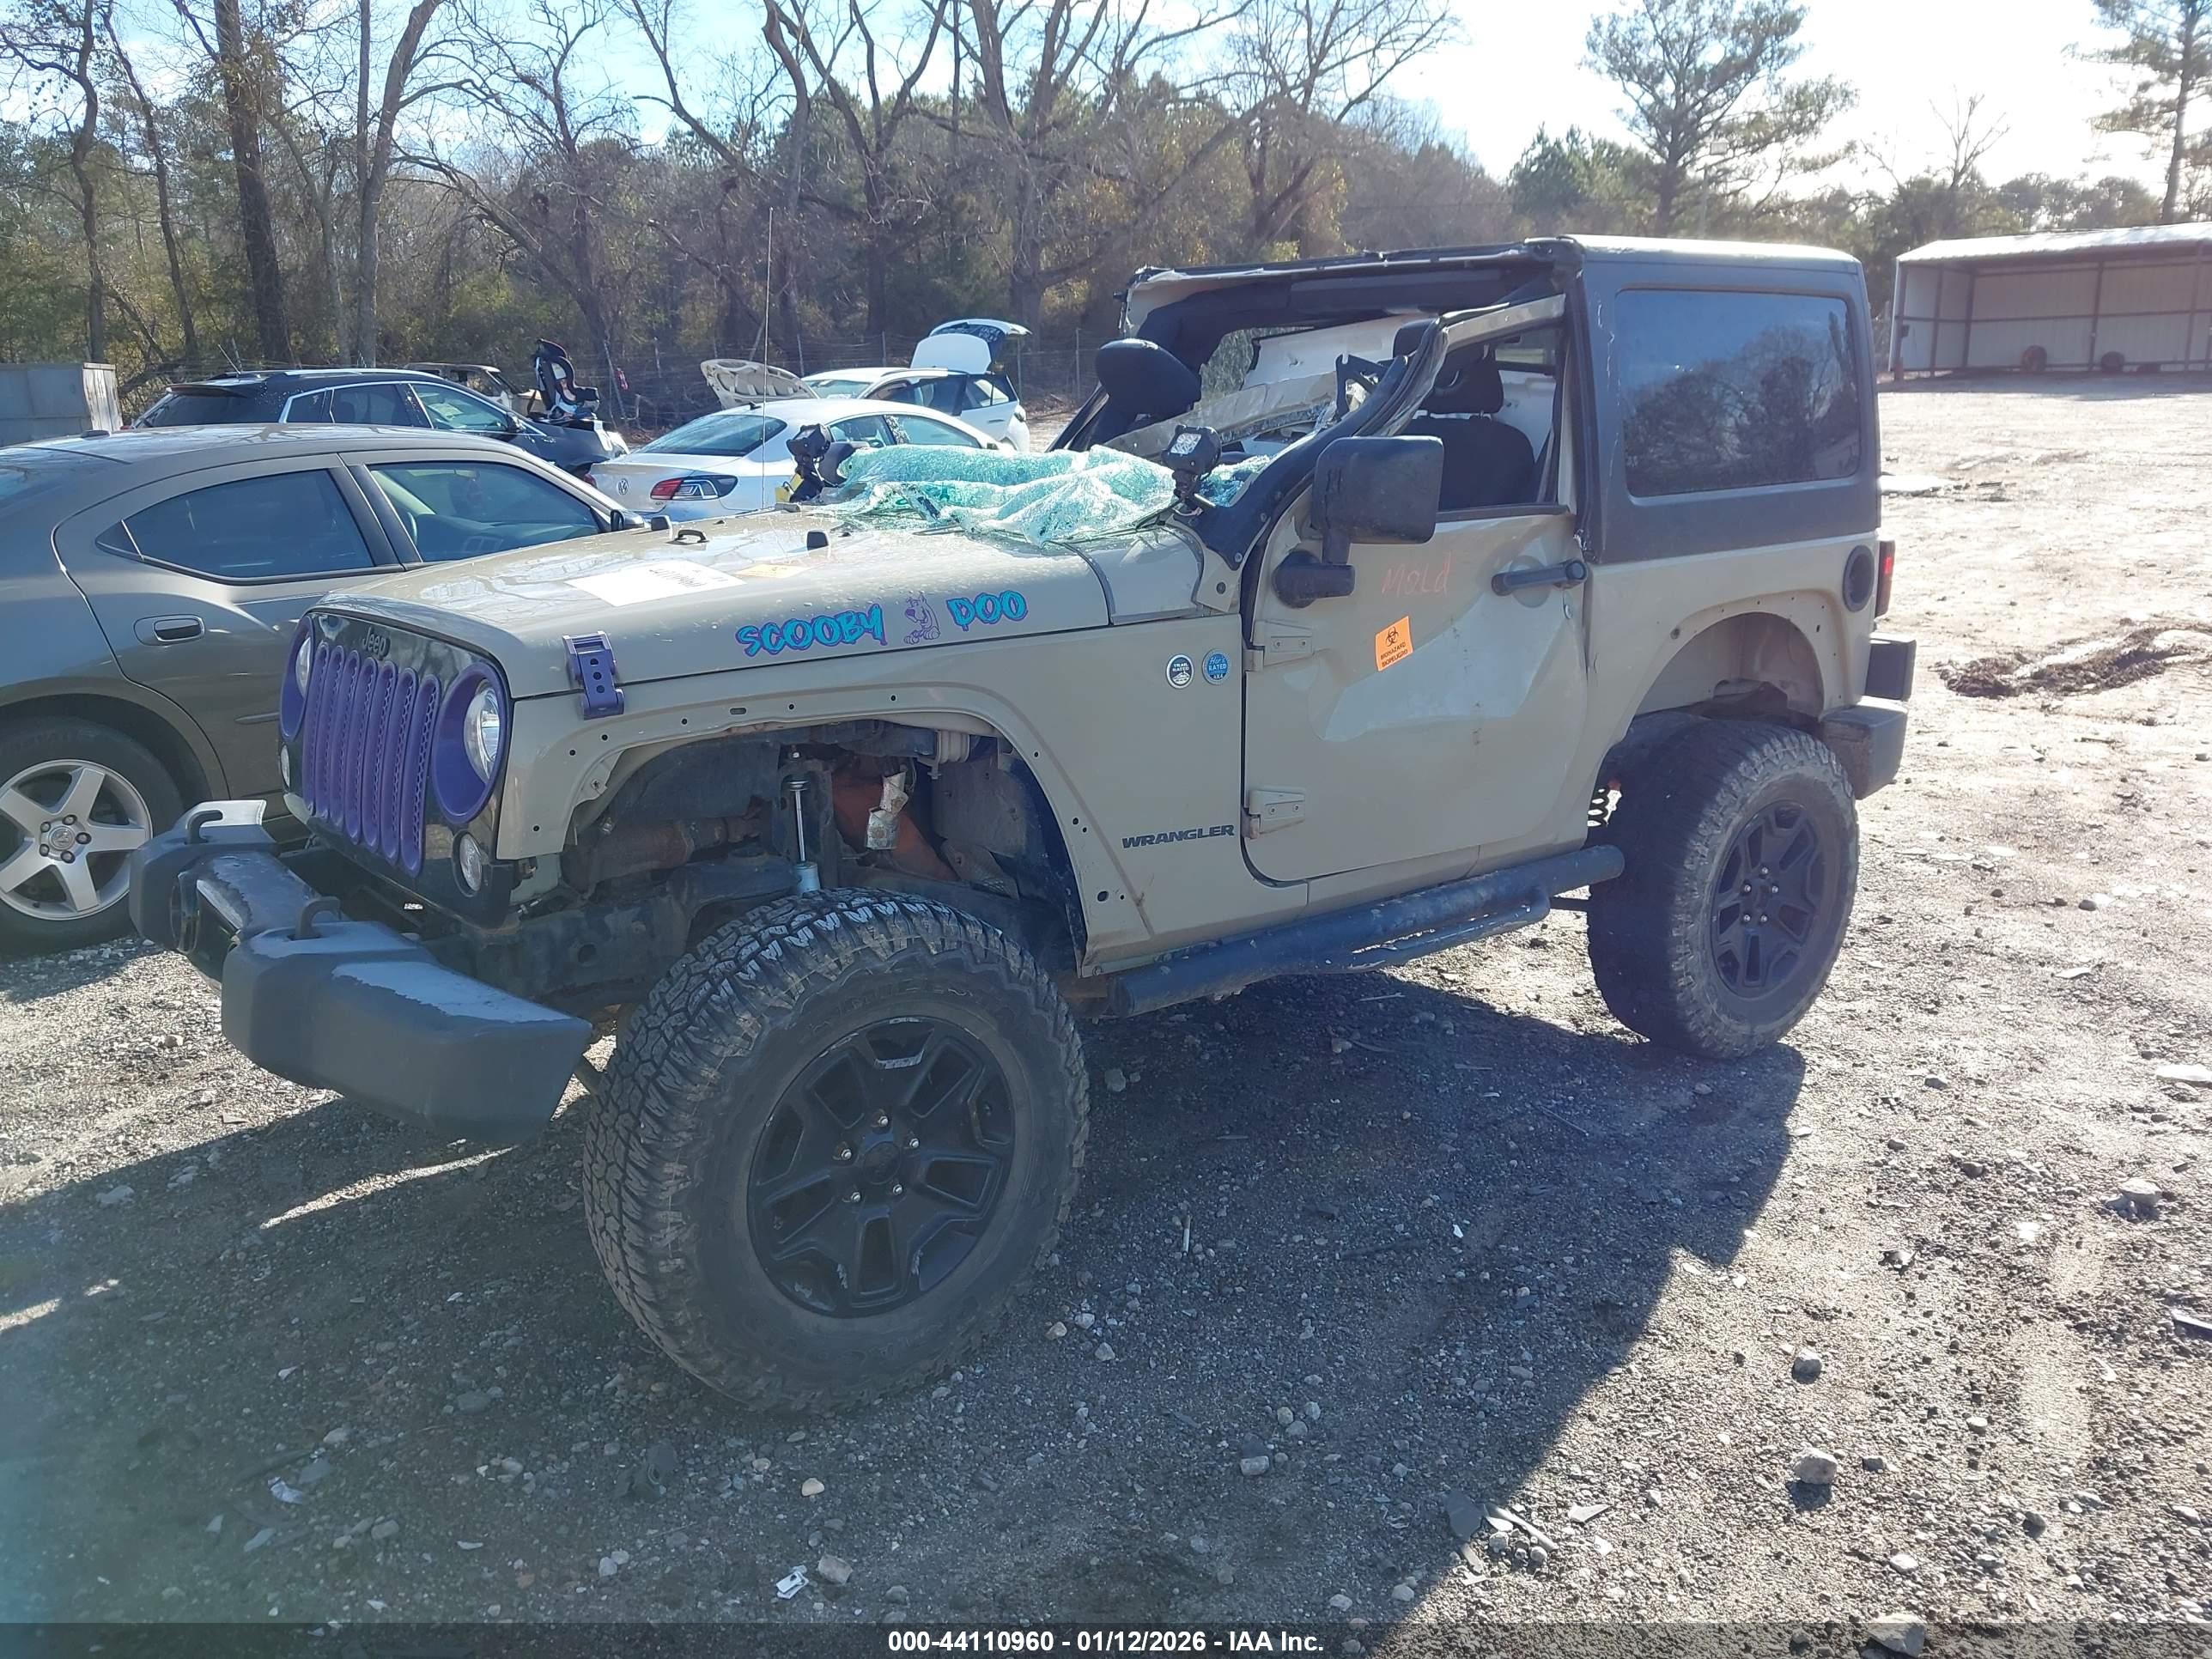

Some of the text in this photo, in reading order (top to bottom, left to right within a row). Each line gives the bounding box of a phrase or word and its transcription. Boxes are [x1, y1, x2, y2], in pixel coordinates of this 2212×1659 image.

[735, 590, 1029, 657] SCOOBY DOO
[362, 627, 388, 657] Jeep
[1380, 641, 1407, 660] BIOHAZARD
[1381, 648, 1408, 667] BIOPELIGRO
[1121, 824, 1235, 848] WRANGLER
